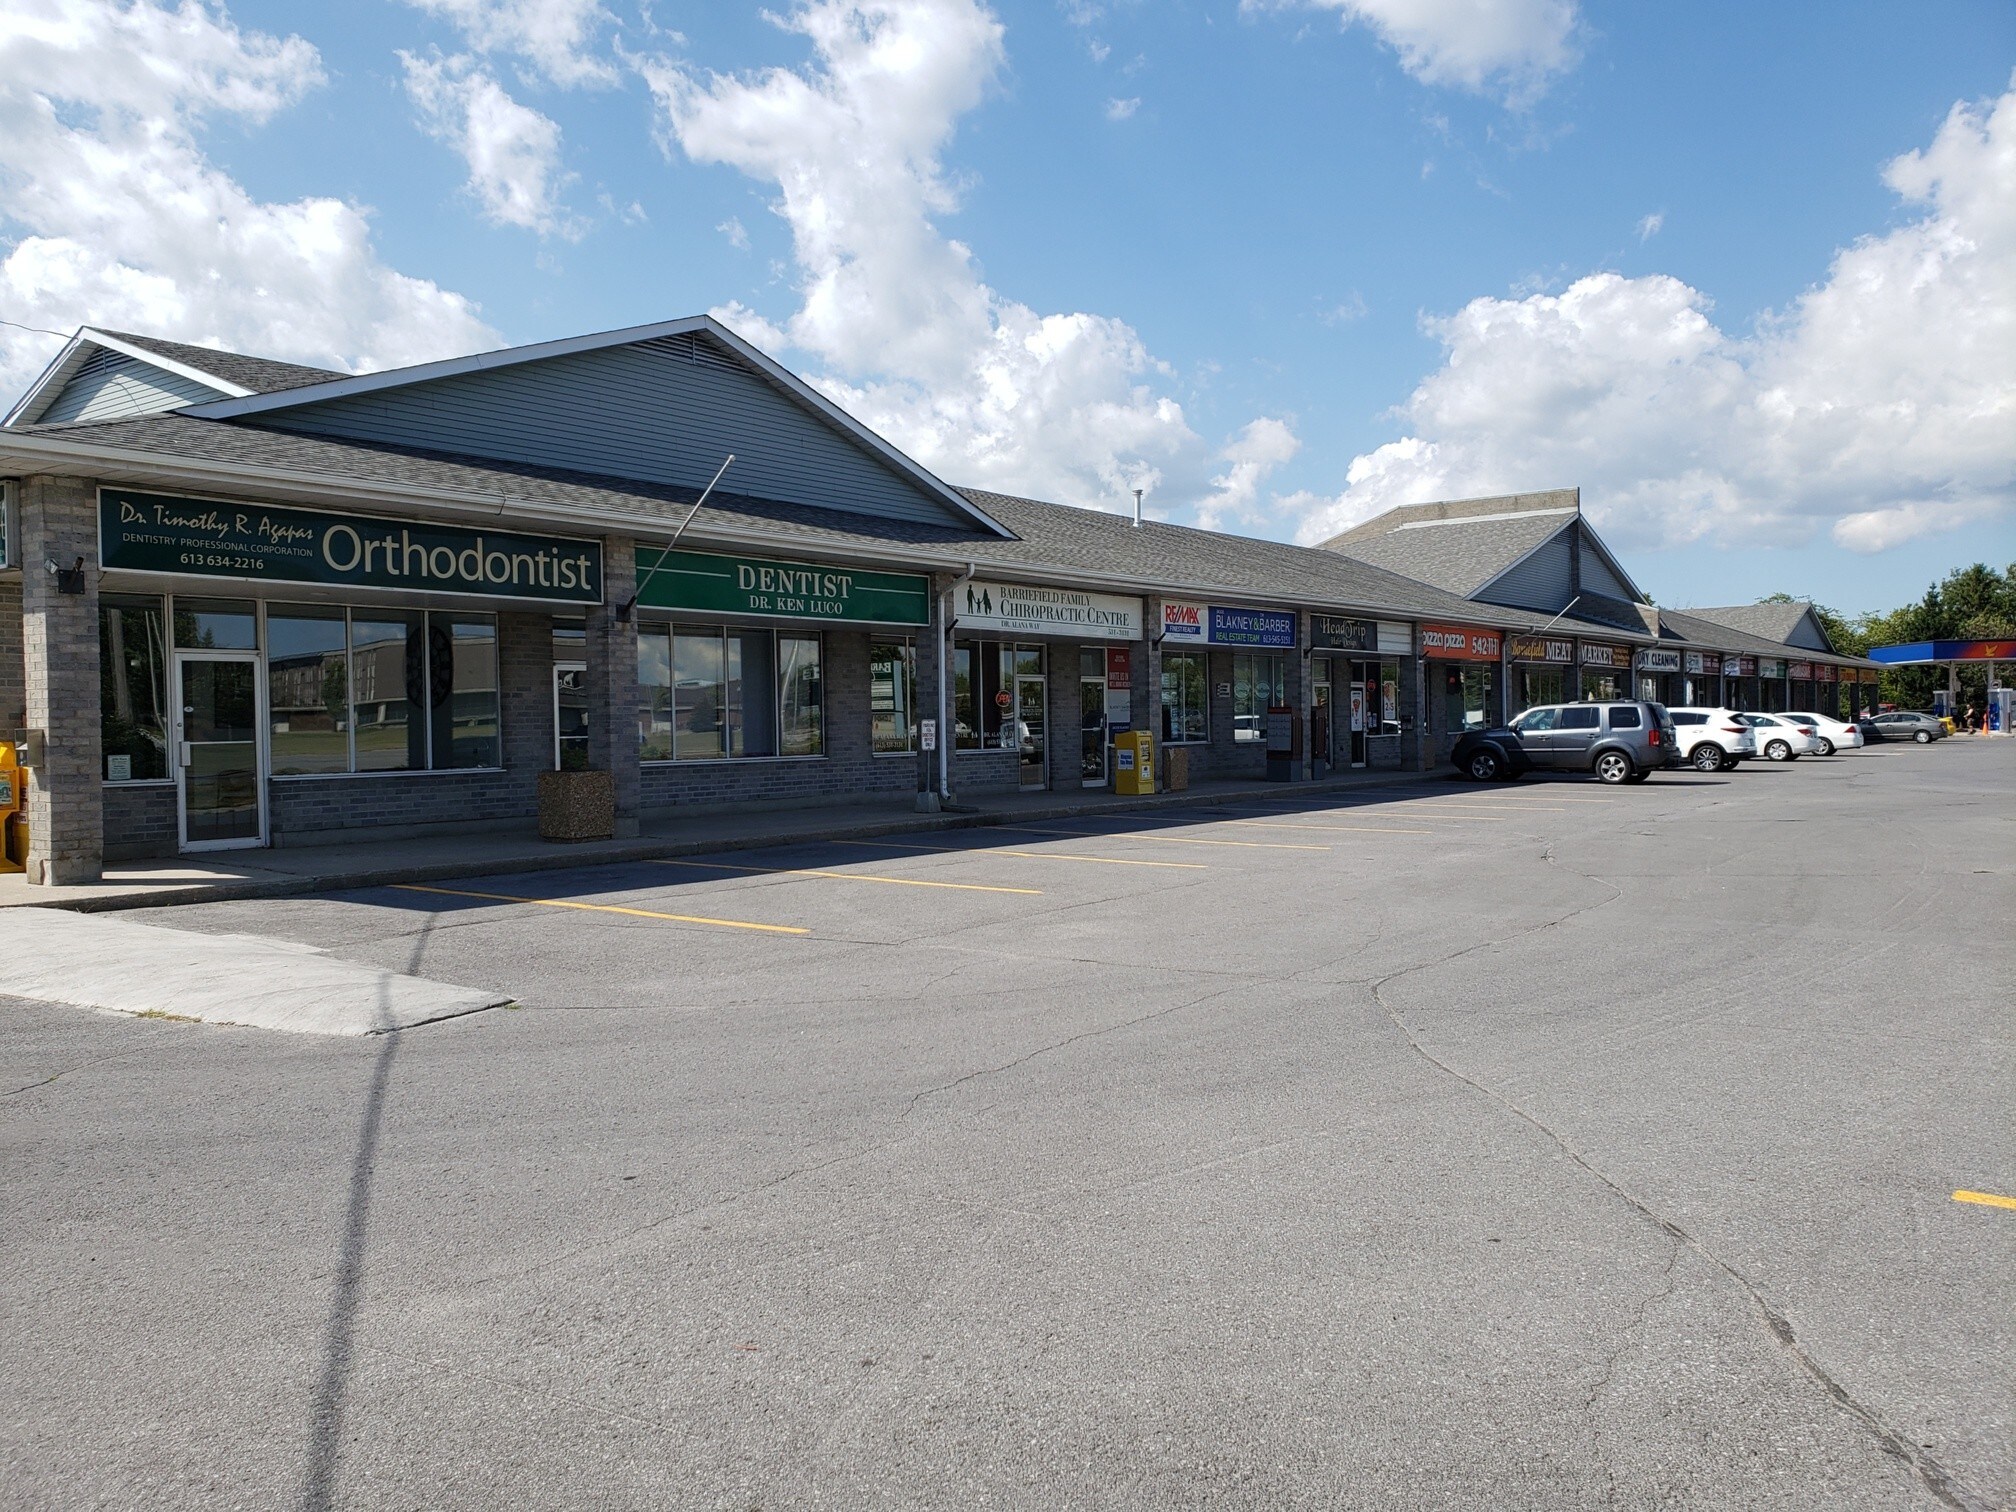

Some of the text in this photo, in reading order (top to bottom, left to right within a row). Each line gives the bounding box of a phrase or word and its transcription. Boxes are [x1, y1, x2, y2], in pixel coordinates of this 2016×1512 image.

[119, 501, 314, 544] Dr. Timothy R. Agapas
[122, 532, 313, 557] DENTISTRY PROFESSIONAL CORPORATION
[180, 553, 264, 569] 613 634-2216
[322, 524, 591, 590] Orthodontist
[737, 565, 852, 599] DENTIST
[749, 595, 843, 615] DR. KEN LUCO
[1000, 587, 1091, 606] BARRIEFIELD FAMILY
[1000, 599, 1129, 627] CHIROPRACTIC CENTRE
[1165, 605, 1201, 624] RE/MAX
[1216, 632, 1228, 641] REAL
[1229, 633, 1246, 642] ESTATE
[1247, 634, 1260, 642] TEAM
[1444, 633, 1466, 652] pizza
[1546, 641, 1572, 661] MEAT
[1651, 653, 1678, 667] CLEANING
